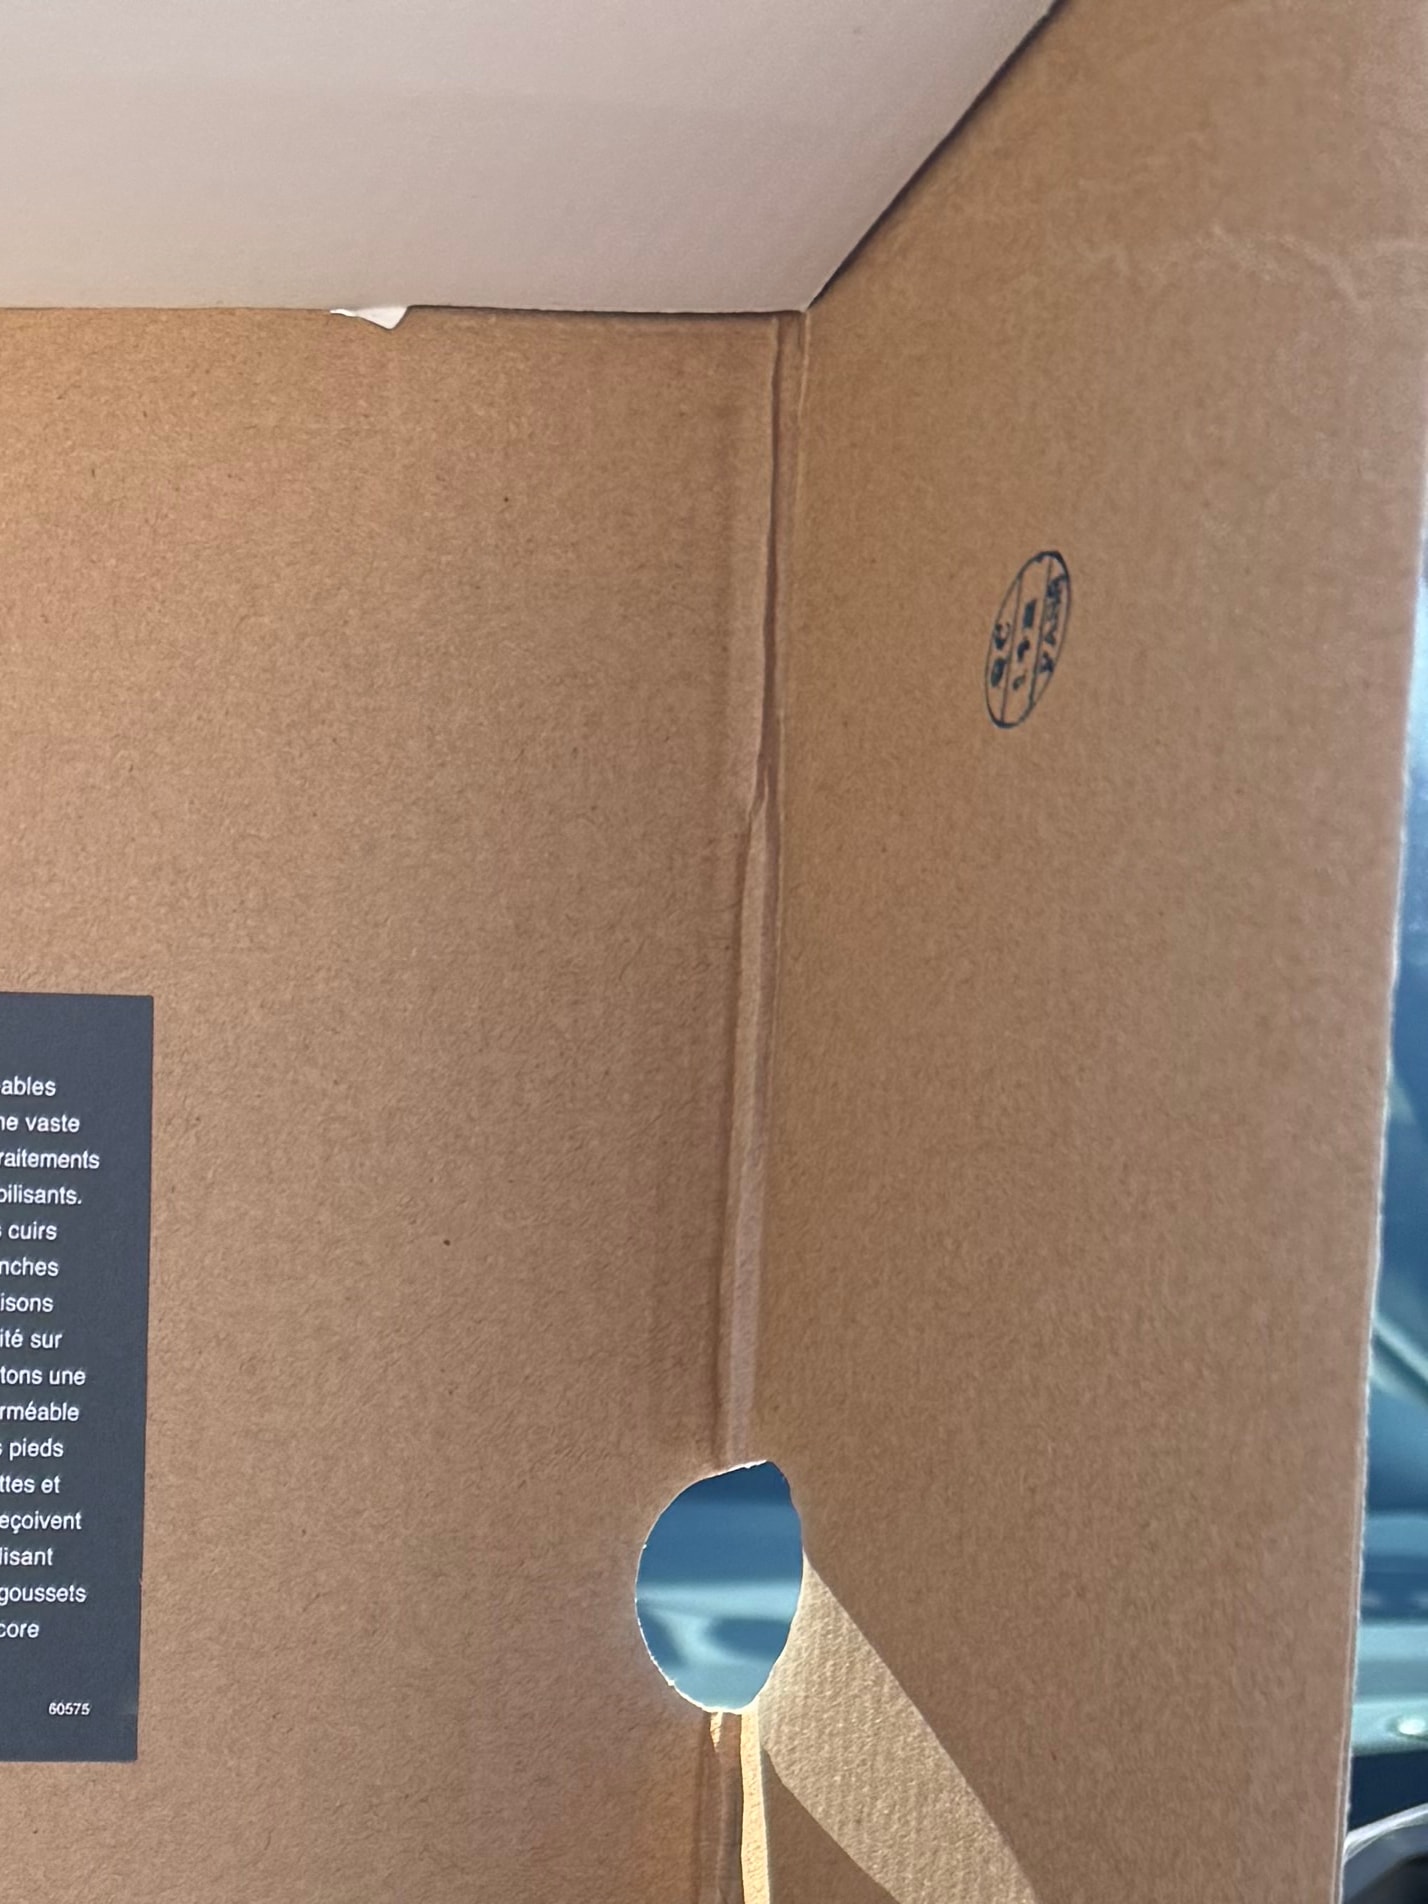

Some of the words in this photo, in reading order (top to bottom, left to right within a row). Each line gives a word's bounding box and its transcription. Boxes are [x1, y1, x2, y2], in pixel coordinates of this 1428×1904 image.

[25, 1113, 80, 1132] vaste
[8, 1220, 57, 1240] cuirs
[30, 1332, 62, 1348] sur
[49, 1369, 86, 1385] une
[9, 1437, 64, 1461] pieds
[40, 1475, 60, 1493] et
[47, 1701, 91, 1717] 60575
